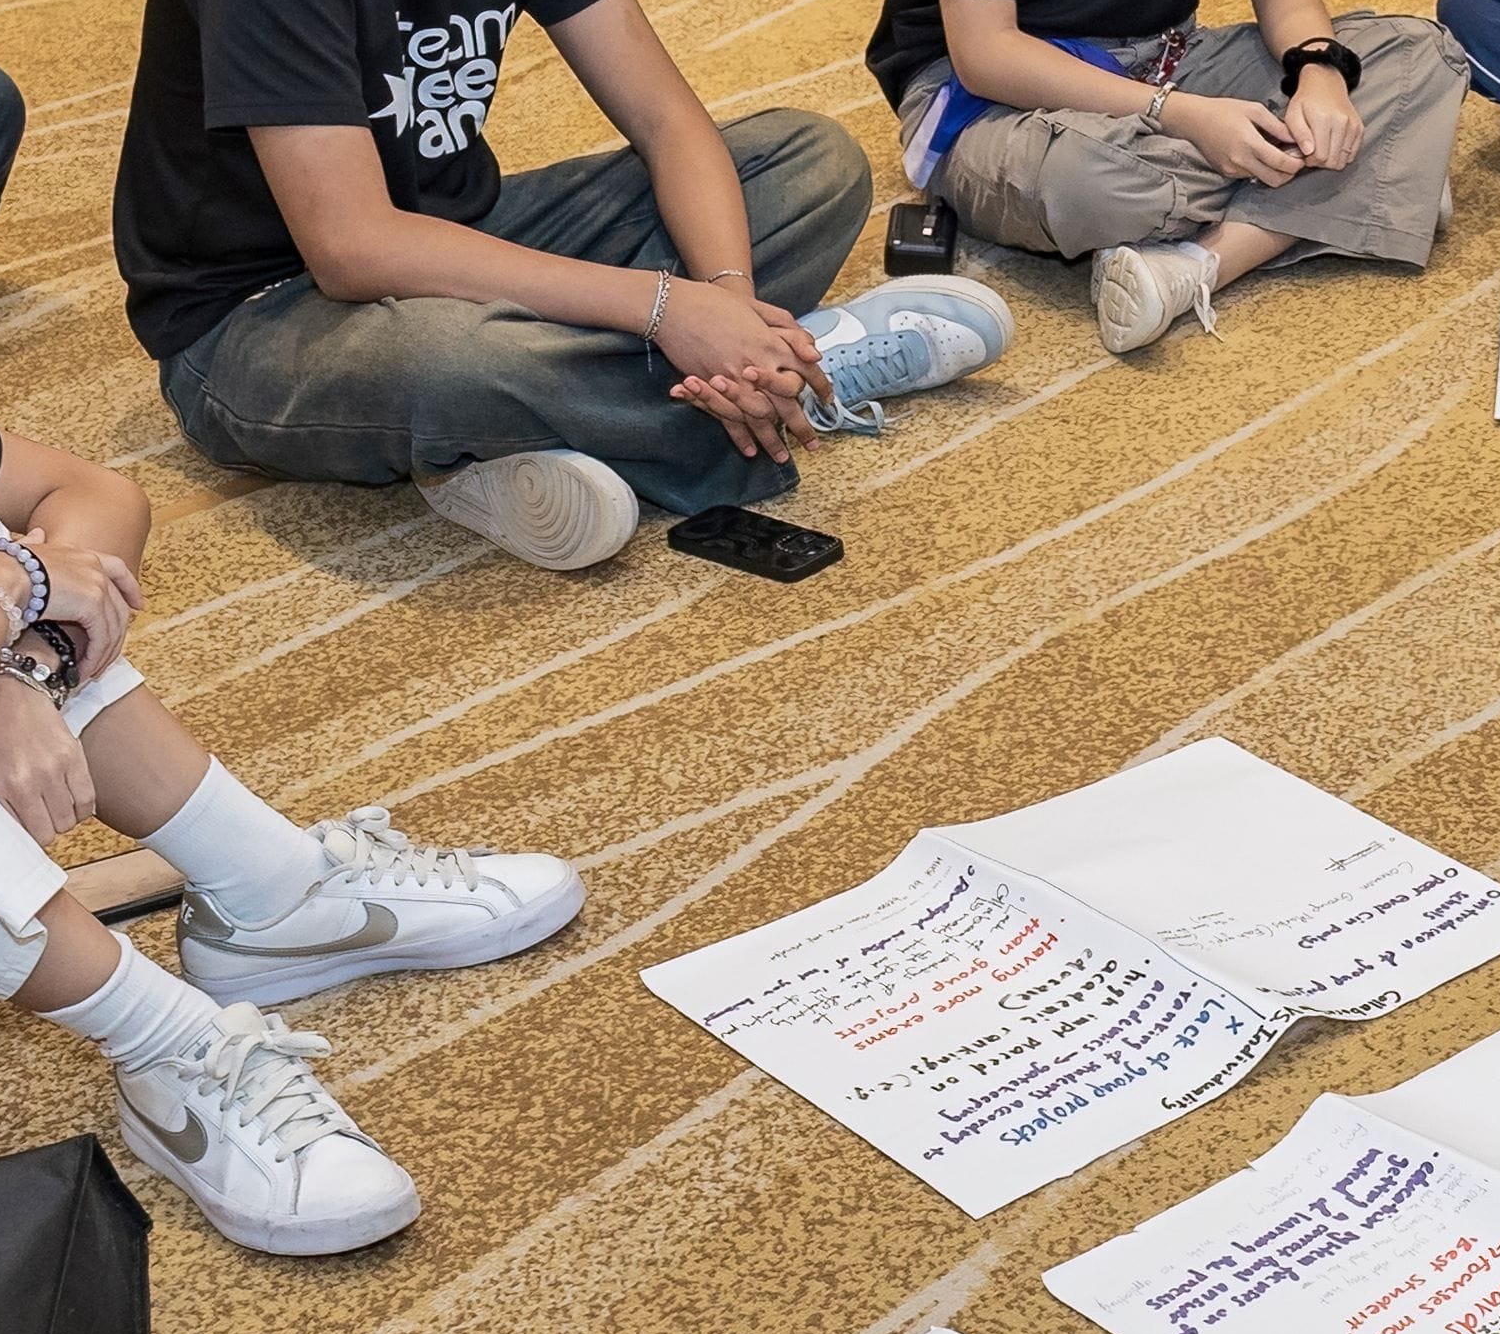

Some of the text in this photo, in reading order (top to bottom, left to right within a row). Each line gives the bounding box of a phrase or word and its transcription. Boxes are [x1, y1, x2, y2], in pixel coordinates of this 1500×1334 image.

[1371, 873, 1446, 915] peer eval
[833, 956, 989, 1040] group projects
[852, 931, 1059, 1051] Having more exams
[929, 1075, 960, 1092] on
[998, 997, 1226, 1147] Lack of group projects
[1159, 1023, 1278, 1110] Individuality
[1417, 1254, 1492, 1315] focuses
